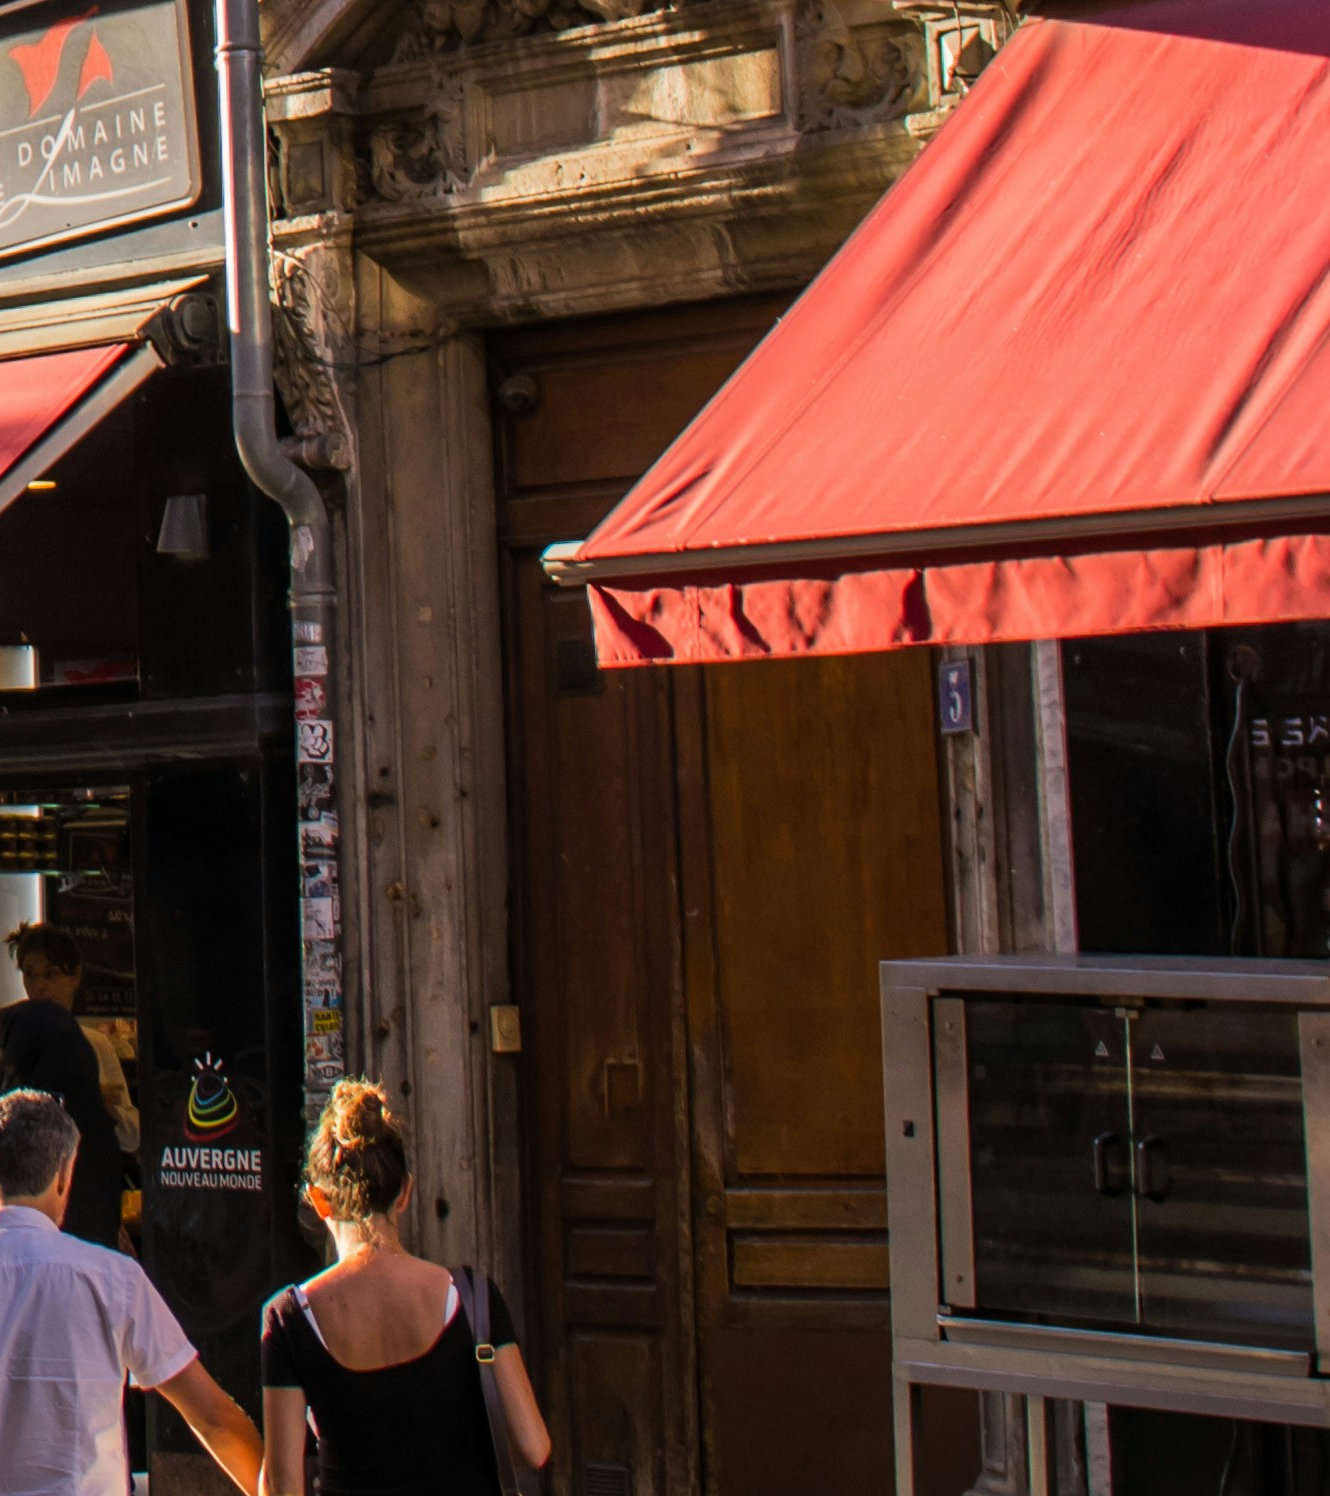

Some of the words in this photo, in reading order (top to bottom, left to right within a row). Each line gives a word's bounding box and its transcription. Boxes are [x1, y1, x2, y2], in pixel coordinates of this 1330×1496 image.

[17, 101, 166, 167] DOMAINE
[161, 1147, 262, 1171] AUVERGNE
[161, 1171, 218, 1188] NOUVEAU
[219, 1174, 262, 1190] MONDE
